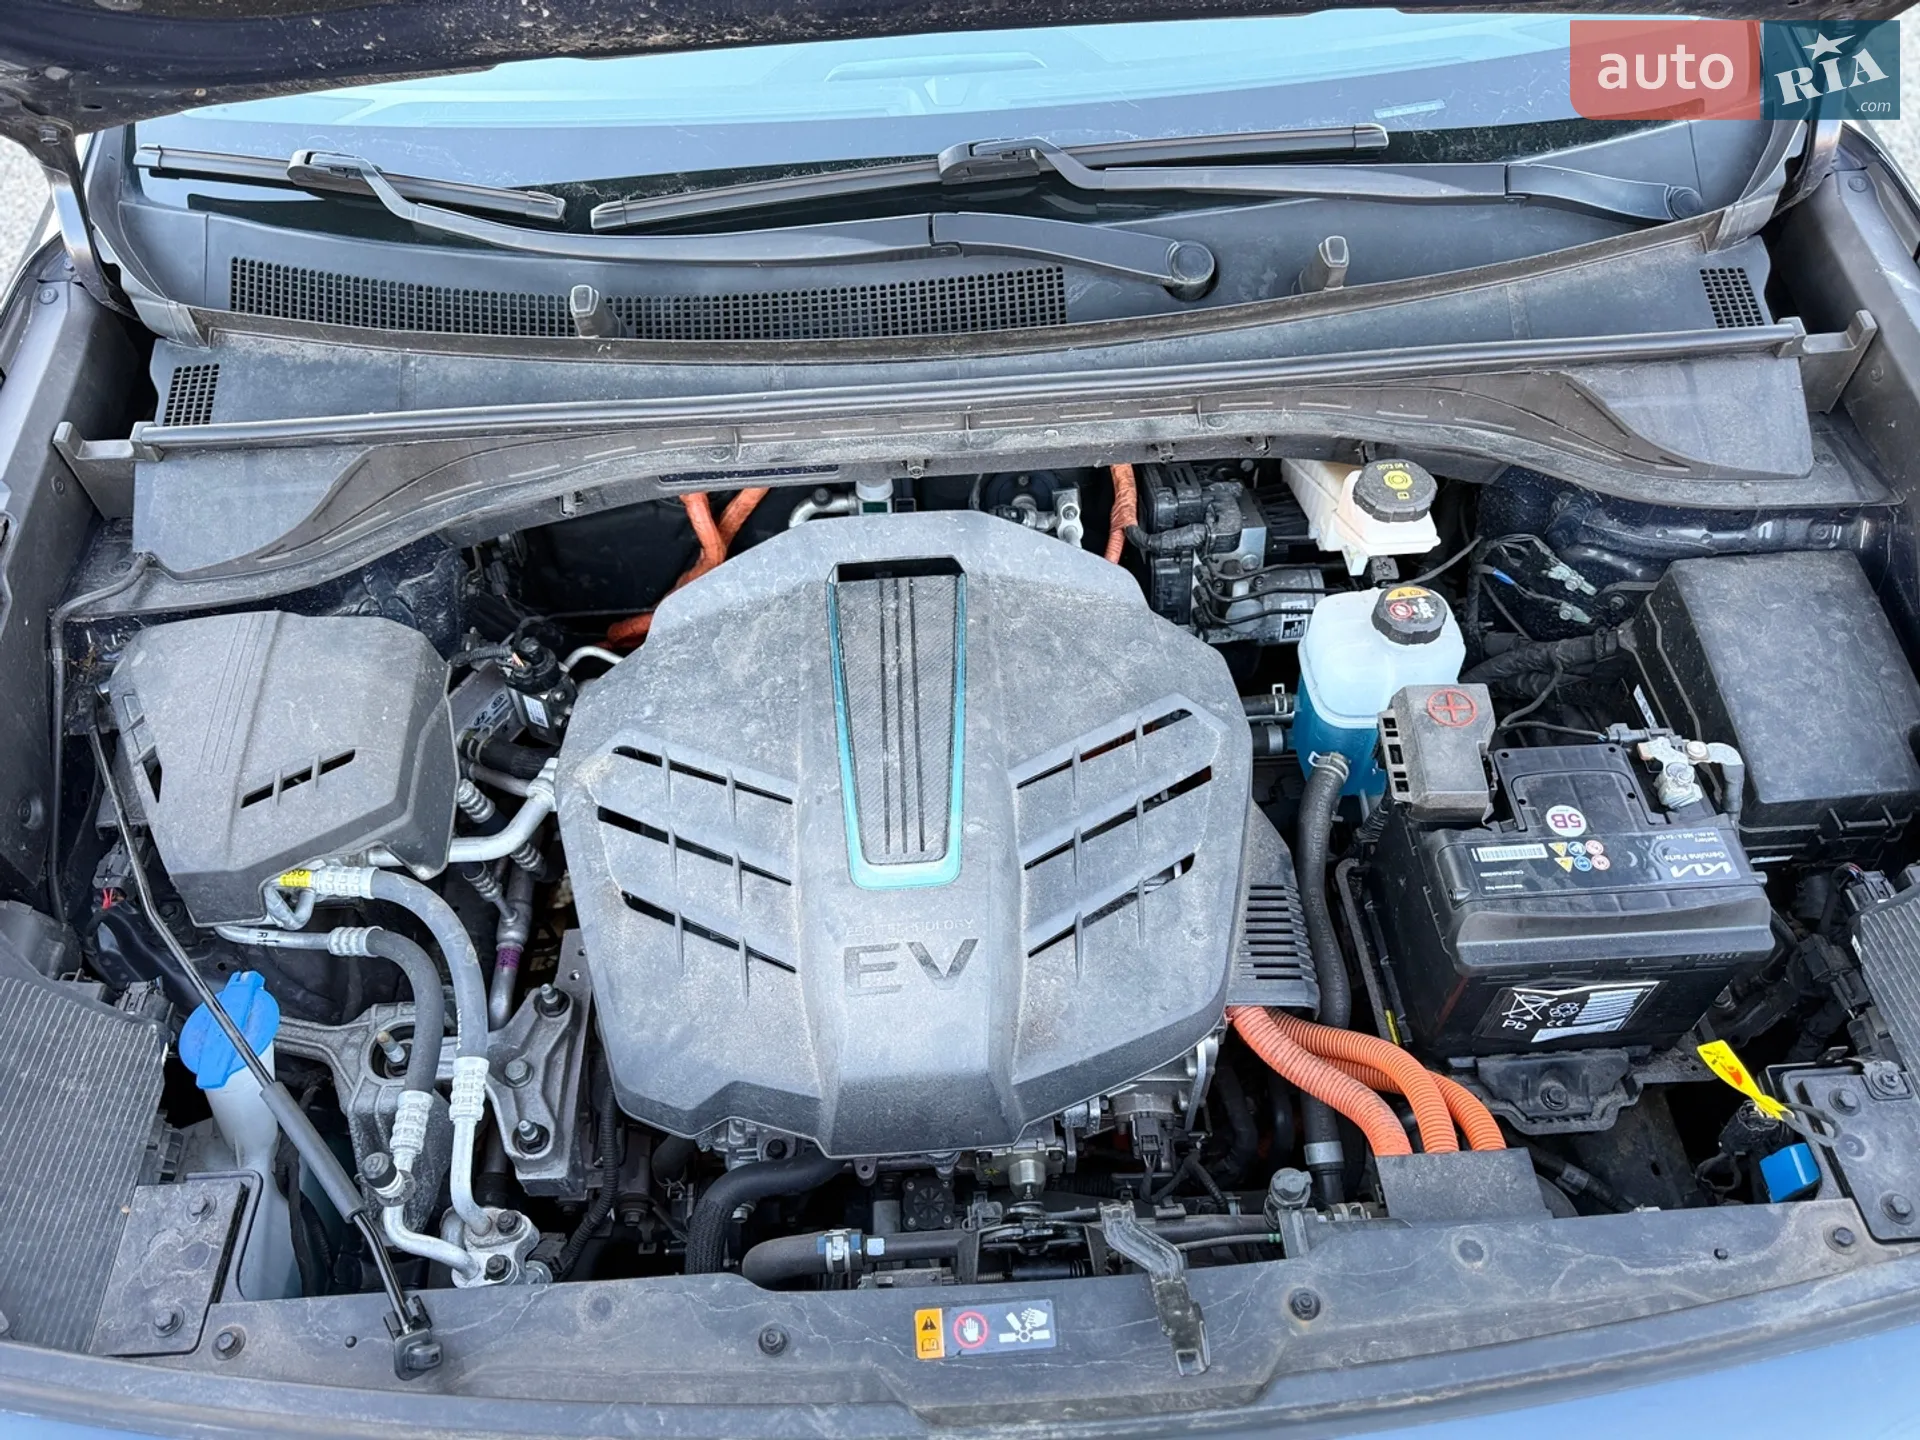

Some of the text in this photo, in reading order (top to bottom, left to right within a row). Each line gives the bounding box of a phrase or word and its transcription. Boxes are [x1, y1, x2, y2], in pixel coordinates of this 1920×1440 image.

[1550, 812, 1582, 829] 5B
[844, 938, 979, 996] EV
[1502, 1019, 1527, 1031] Pb
